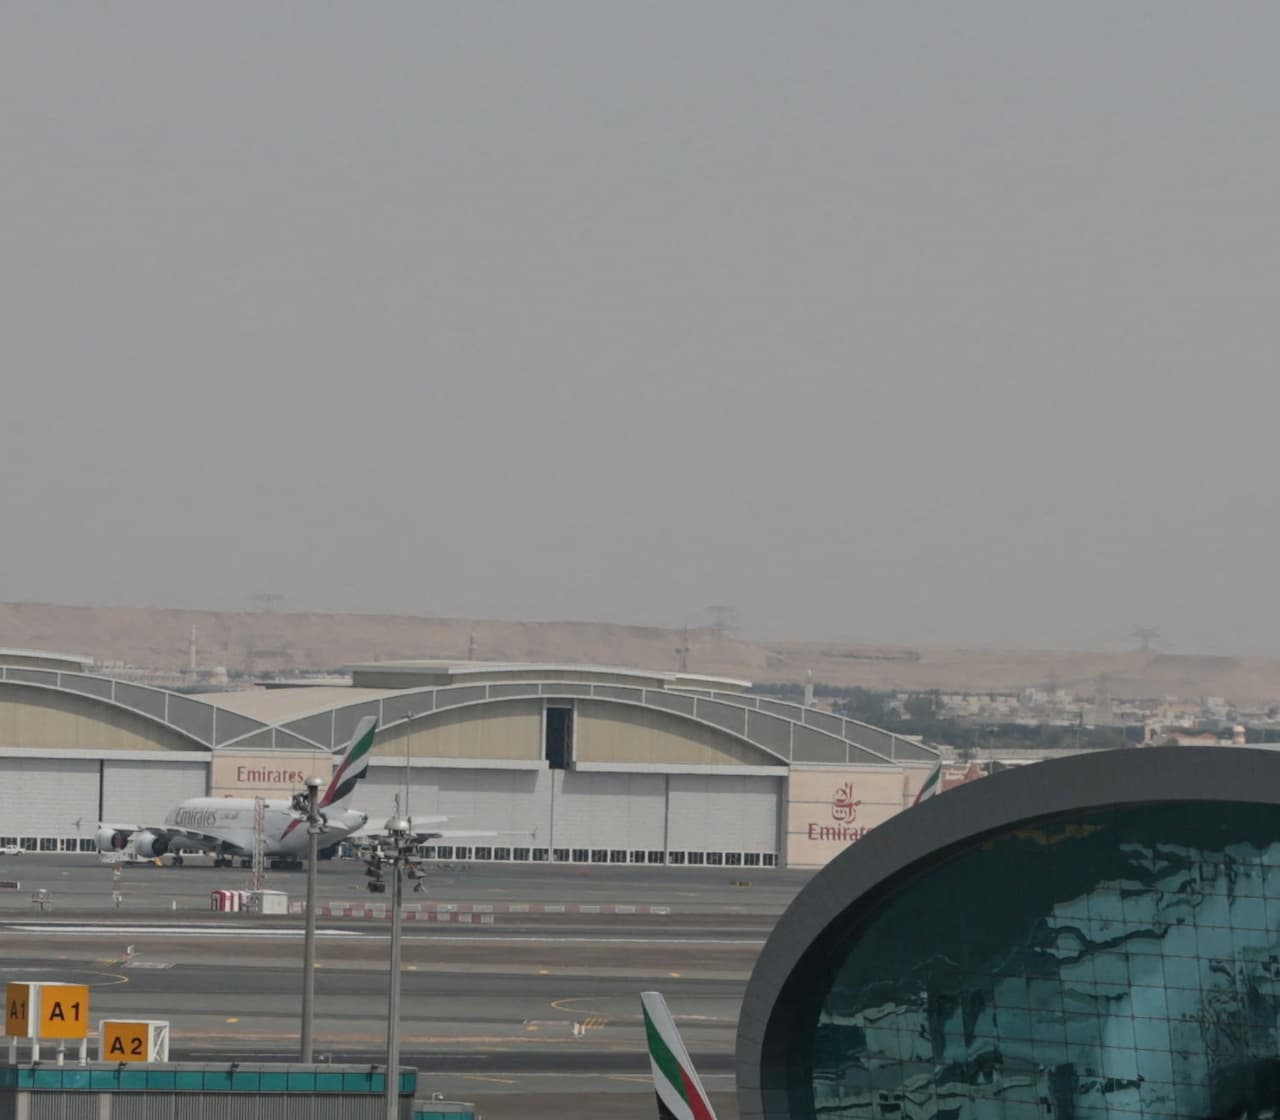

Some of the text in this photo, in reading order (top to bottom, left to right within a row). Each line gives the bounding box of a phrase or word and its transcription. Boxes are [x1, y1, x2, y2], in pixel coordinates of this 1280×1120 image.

[236, 766, 304, 784] Emirates
[807, 823, 873, 841] Emirat
[10, 1000, 25, 1021] A1
[49, 1001, 81, 1022] A1
[110, 1037, 143, 1056] A2
